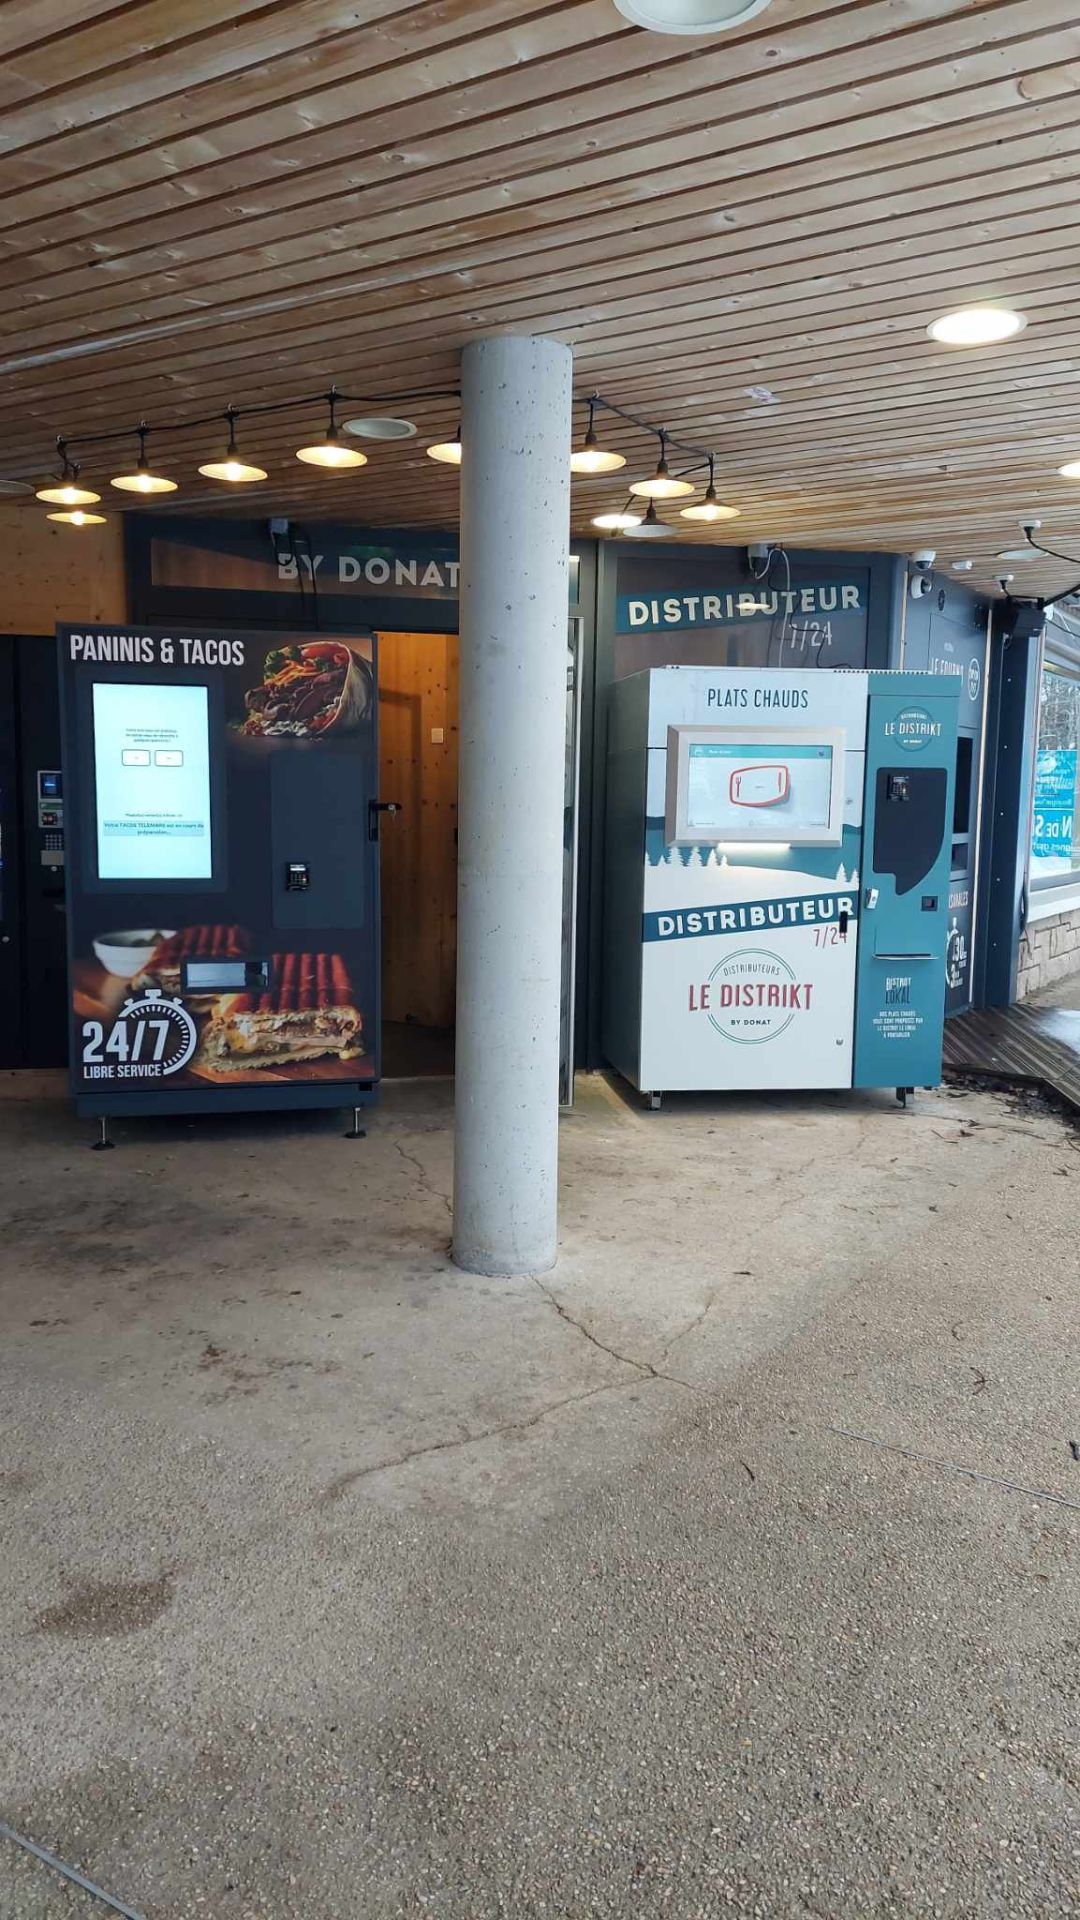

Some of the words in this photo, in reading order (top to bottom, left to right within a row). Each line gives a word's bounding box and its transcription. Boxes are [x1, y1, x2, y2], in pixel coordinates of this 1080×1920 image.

[277, 553, 324, 581] BY
[338, 556, 460, 588] DONAT
[628, 585, 860, 626] DISTRIBUTEUR
[70, 634, 154, 664] PANINIS
[160, 638, 174, 664] &
[179, 638, 245, 666] TACOS
[707, 688, 748, 708] PLATS
[754, 689, 809, 709] CHAUDS
[884, 722, 896, 736] LE
[899, 722, 941, 737] DISTRIKT
[657, 897, 854, 937] DISTRIBUTEUR
[723, 963, 781, 977] DISTRIBUTEURS
[688, 984, 710, 1011] LE
[720, 983, 813, 1010] DISTRIKT
[885, 986, 911, 1004] LOKAL
[82, 1020, 170, 1062] 24/7
[83, 1065, 115, 1079] LIBRE
[117, 1064, 162, 1078] SERVICE
